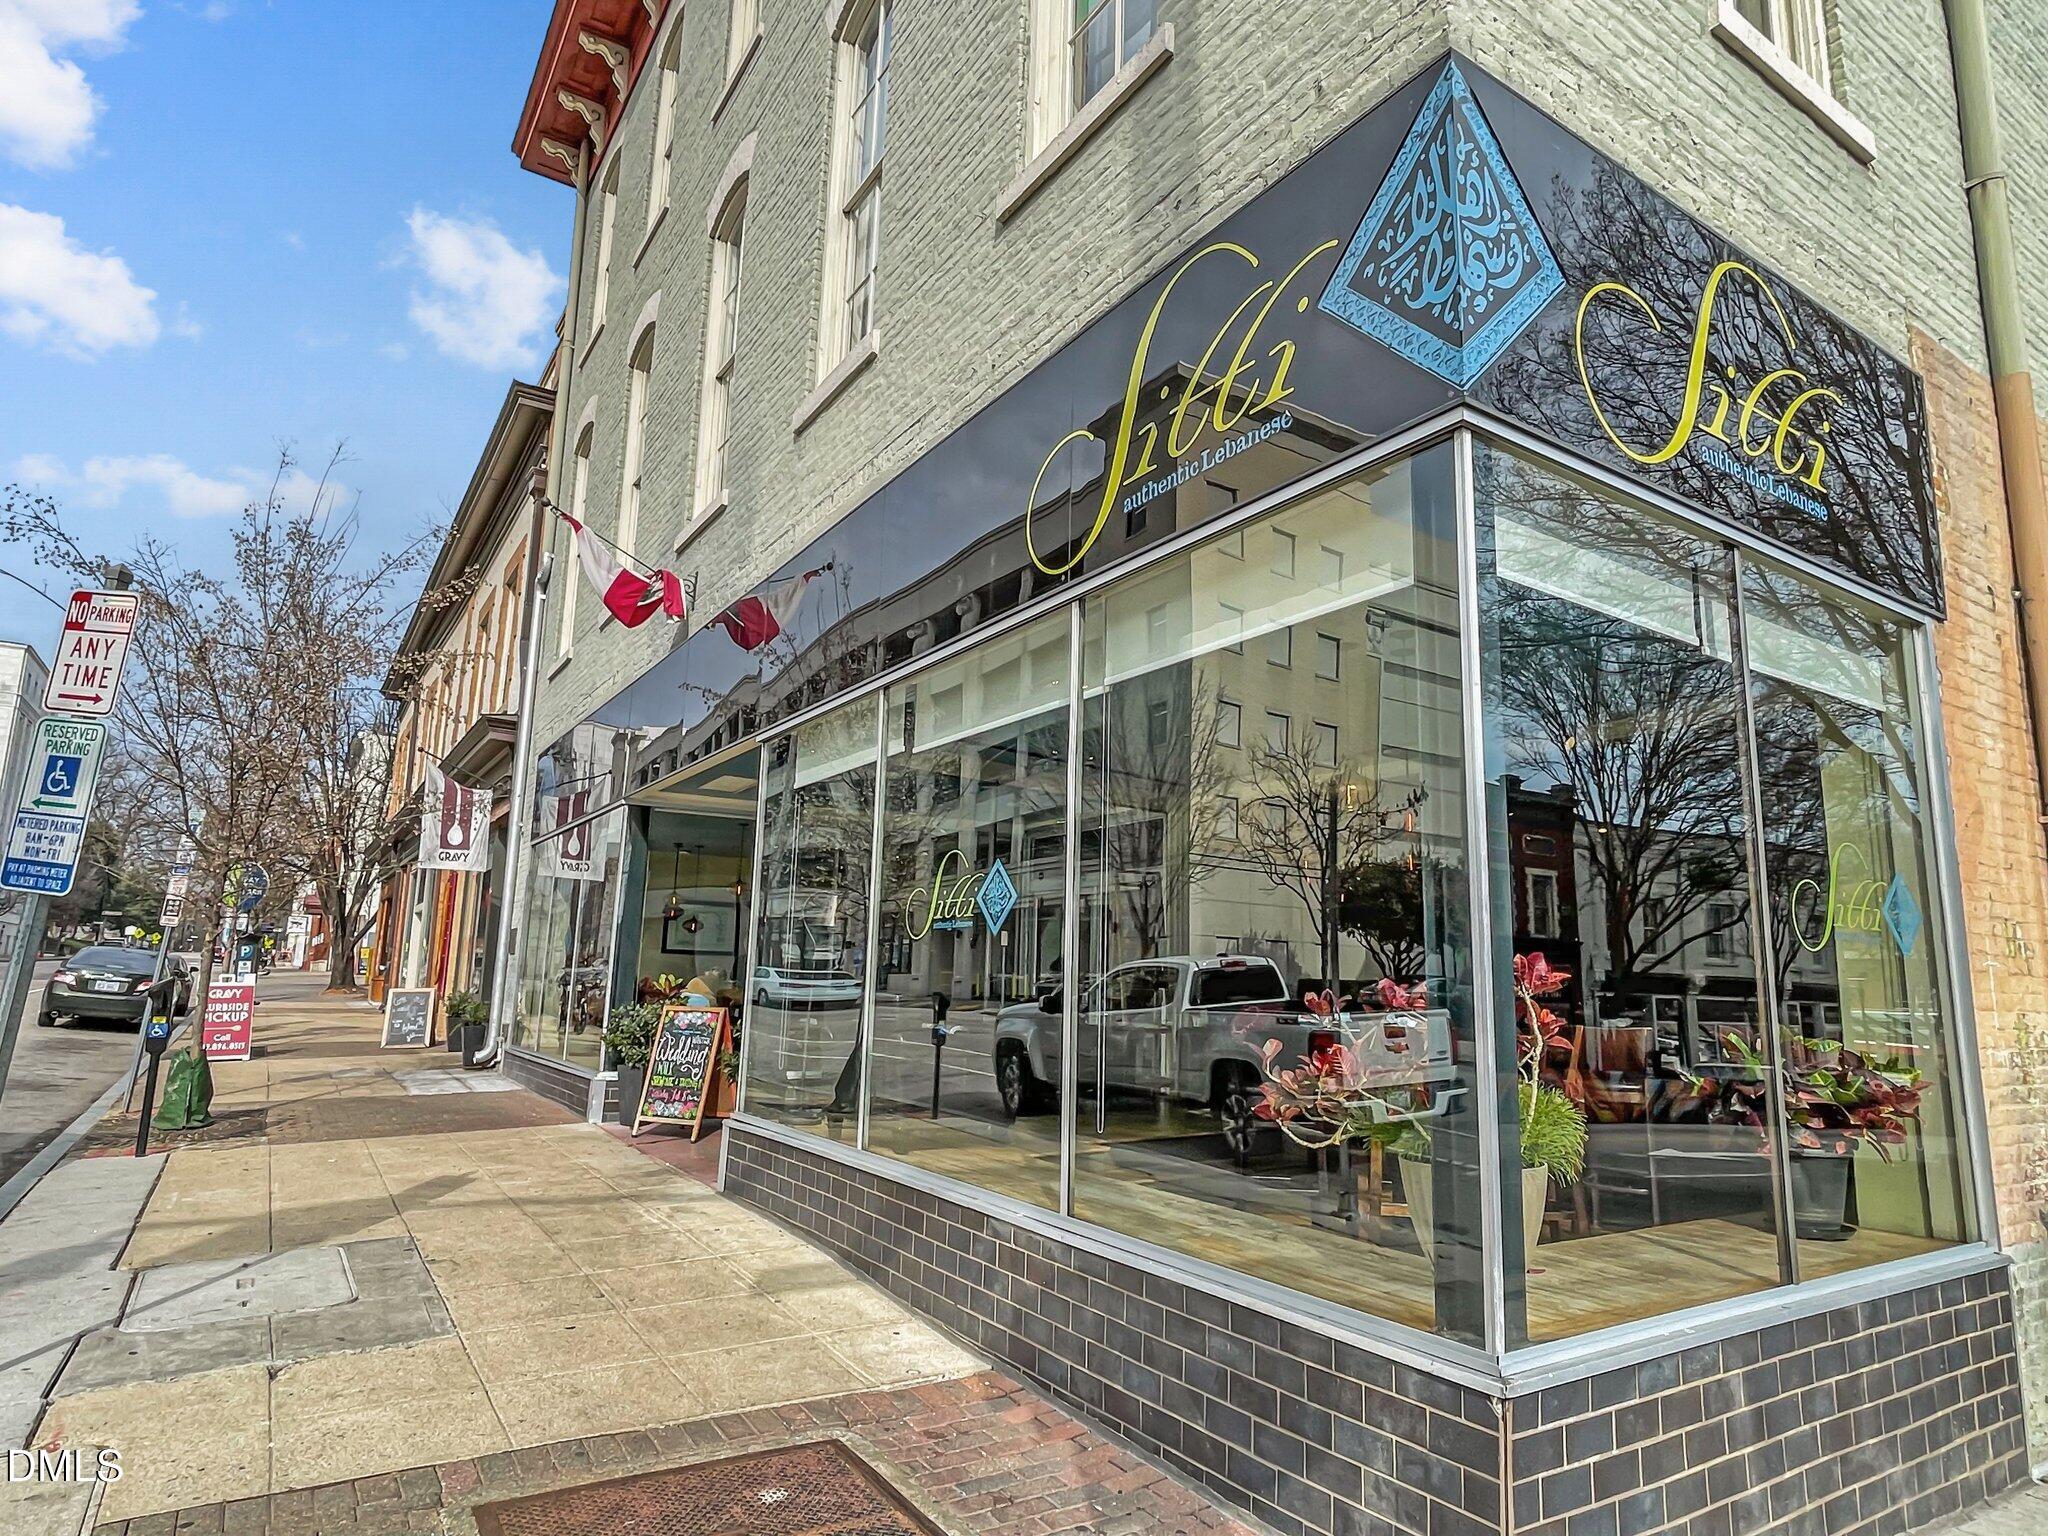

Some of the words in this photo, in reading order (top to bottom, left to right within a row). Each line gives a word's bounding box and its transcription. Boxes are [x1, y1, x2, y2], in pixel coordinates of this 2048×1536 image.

[1574, 261, 1844, 493] Sitti
[1025, 239, 1338, 575] Sitti
[1123, 460, 1199, 514] authentic
[1200, 411, 1294, 472] Lebanese
[1701, 445, 1768, 491] authentic
[1766, 473, 1829, 522] Lebanese
[67, 600, 89, 623] NO
[89, 605, 133, 624] PARKING
[69, 636, 116, 661] ANY
[62, 663, 113, 689] TIME
[43, 723, 99, 742] RESERVED
[45, 739, 91, 756] PARKING
[17, 816, 49, 831] METERED
[48, 819, 80, 834] PARKING
[438, 851, 470, 863] GRAVY
[905, 849, 985, 940] Sitti
[1791, 842, 1888, 952] Sitti
[208, 988, 243, 999] GRAVY
[206, 1002, 250, 1012] URBSIDE
[213, 1033, 232, 1041] Call
[655, 1031, 709, 1080] Wedding
